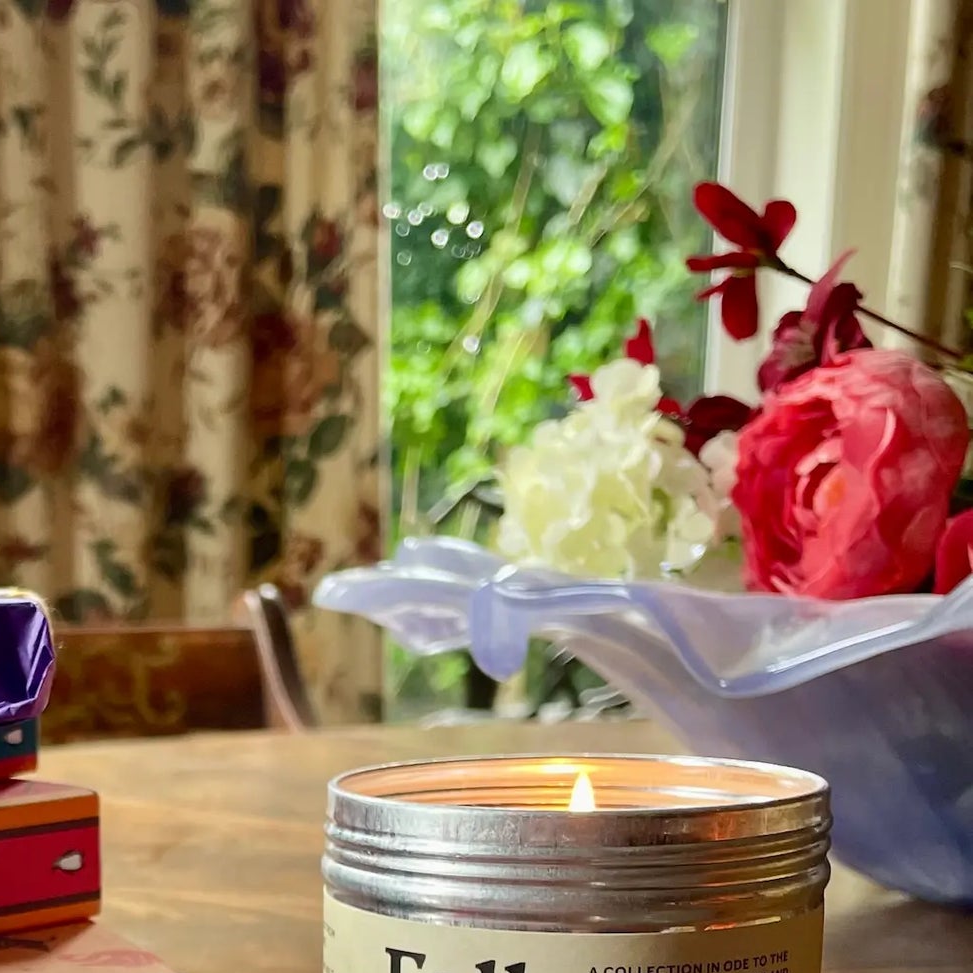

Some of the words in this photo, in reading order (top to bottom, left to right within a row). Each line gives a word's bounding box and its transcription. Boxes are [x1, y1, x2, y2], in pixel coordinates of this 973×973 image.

[706, 961, 721, 973] IN
[723, 958, 750, 972] ODE
[753, 955, 768, 967] TO
[770, 951, 789, 965] THE
